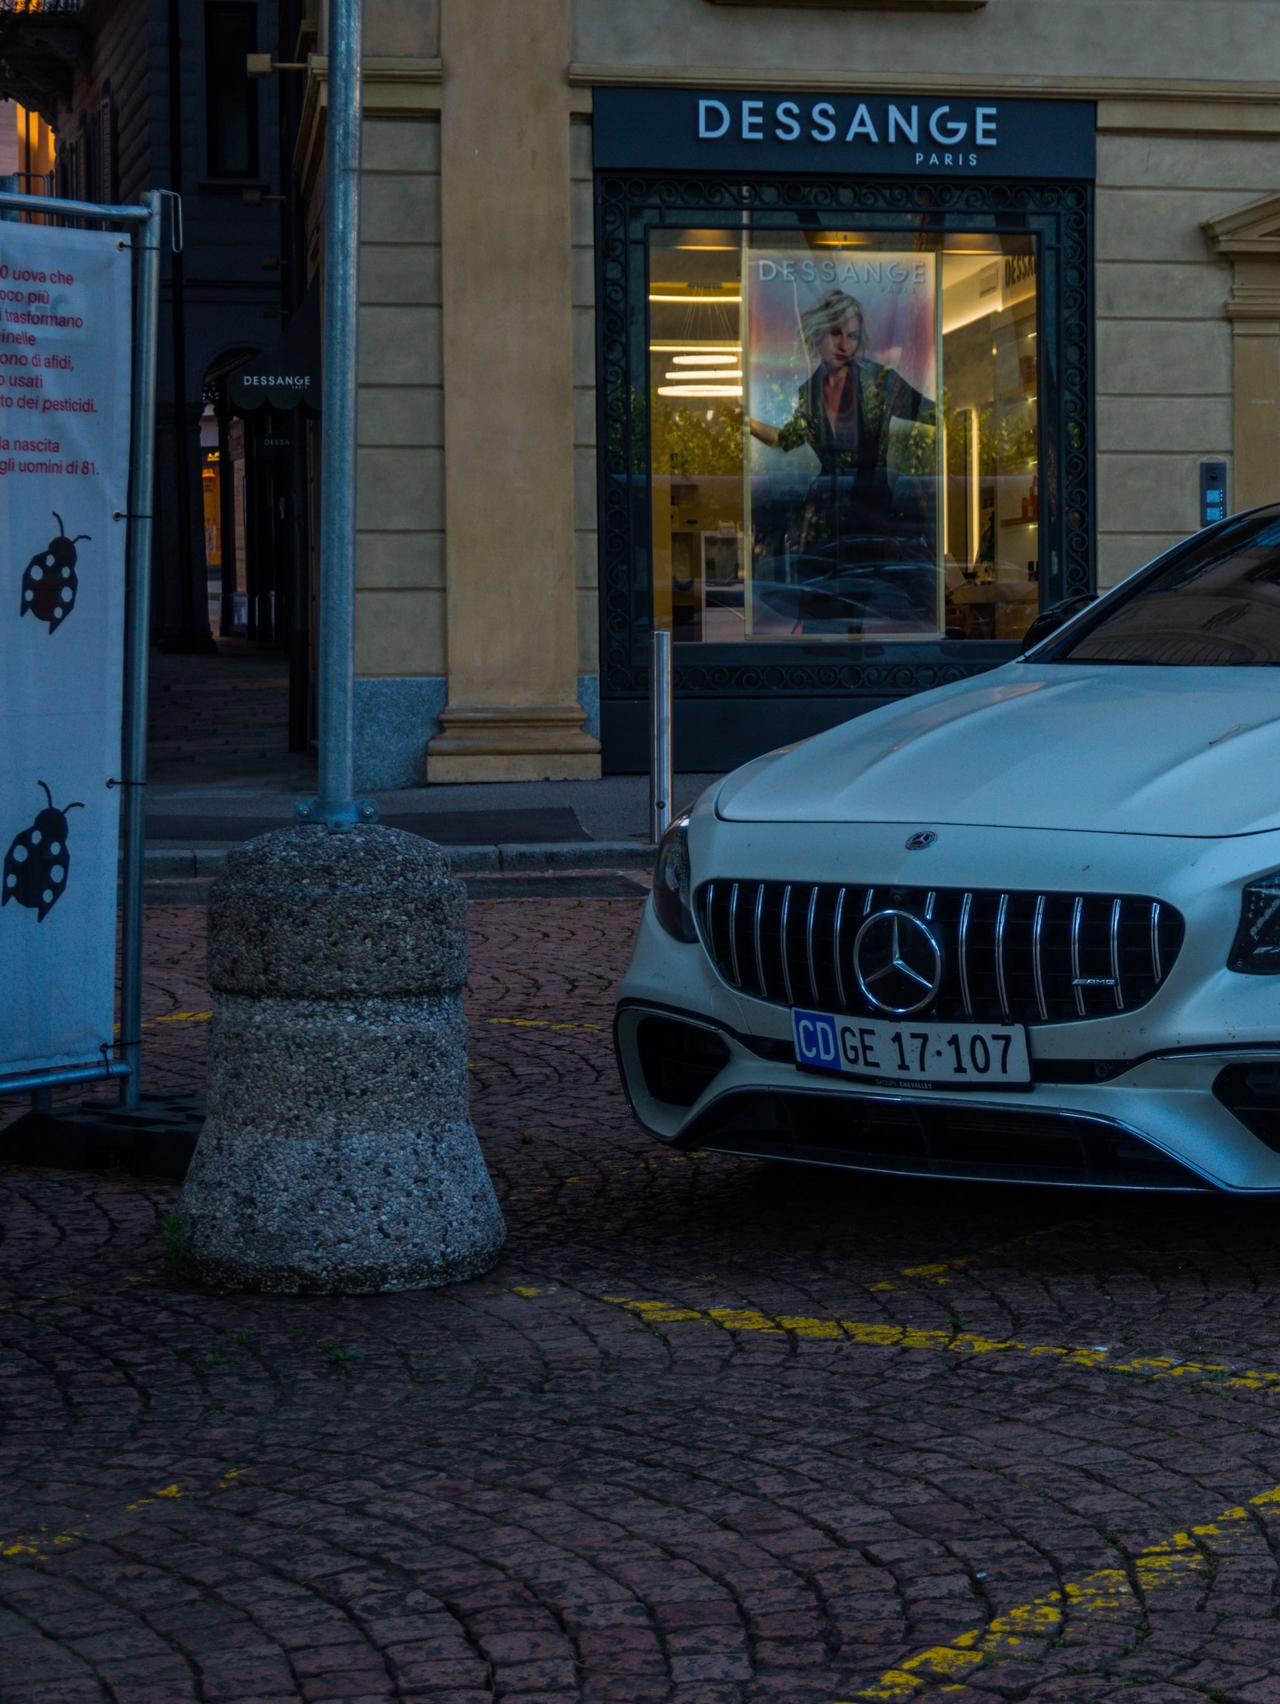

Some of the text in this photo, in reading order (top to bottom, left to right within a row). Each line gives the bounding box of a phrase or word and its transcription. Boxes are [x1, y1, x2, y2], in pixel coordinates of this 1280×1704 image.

[698, 99, 997, 146] DESSANGE
[915, 153, 978, 166] PARIS
[12, 269, 46, 283] uova
[49, 270, 74, 285] che
[758, 259, 925, 284] DESSANGE
[28, 289, 49, 306] più
[5, 308, 83, 329] trasformano
[0, 352, 74, 371] ono di afidi,
[9, 374, 43, 389] usati
[243, 375, 311, 386] DESSANGE
[17, 394, 39, 409] dei
[42, 396, 97, 413] pesticidi.
[14, 437, 60, 453] nascita
[0, 457, 99, 476] gli uomini di 81.
[1086, 978, 1115, 986] AMG
[799, 1019, 836, 1062] CD
[840, 1026, 881, 1068] GE
[875, 1078, 933, 1090] GROUPE CHEVALLEY
